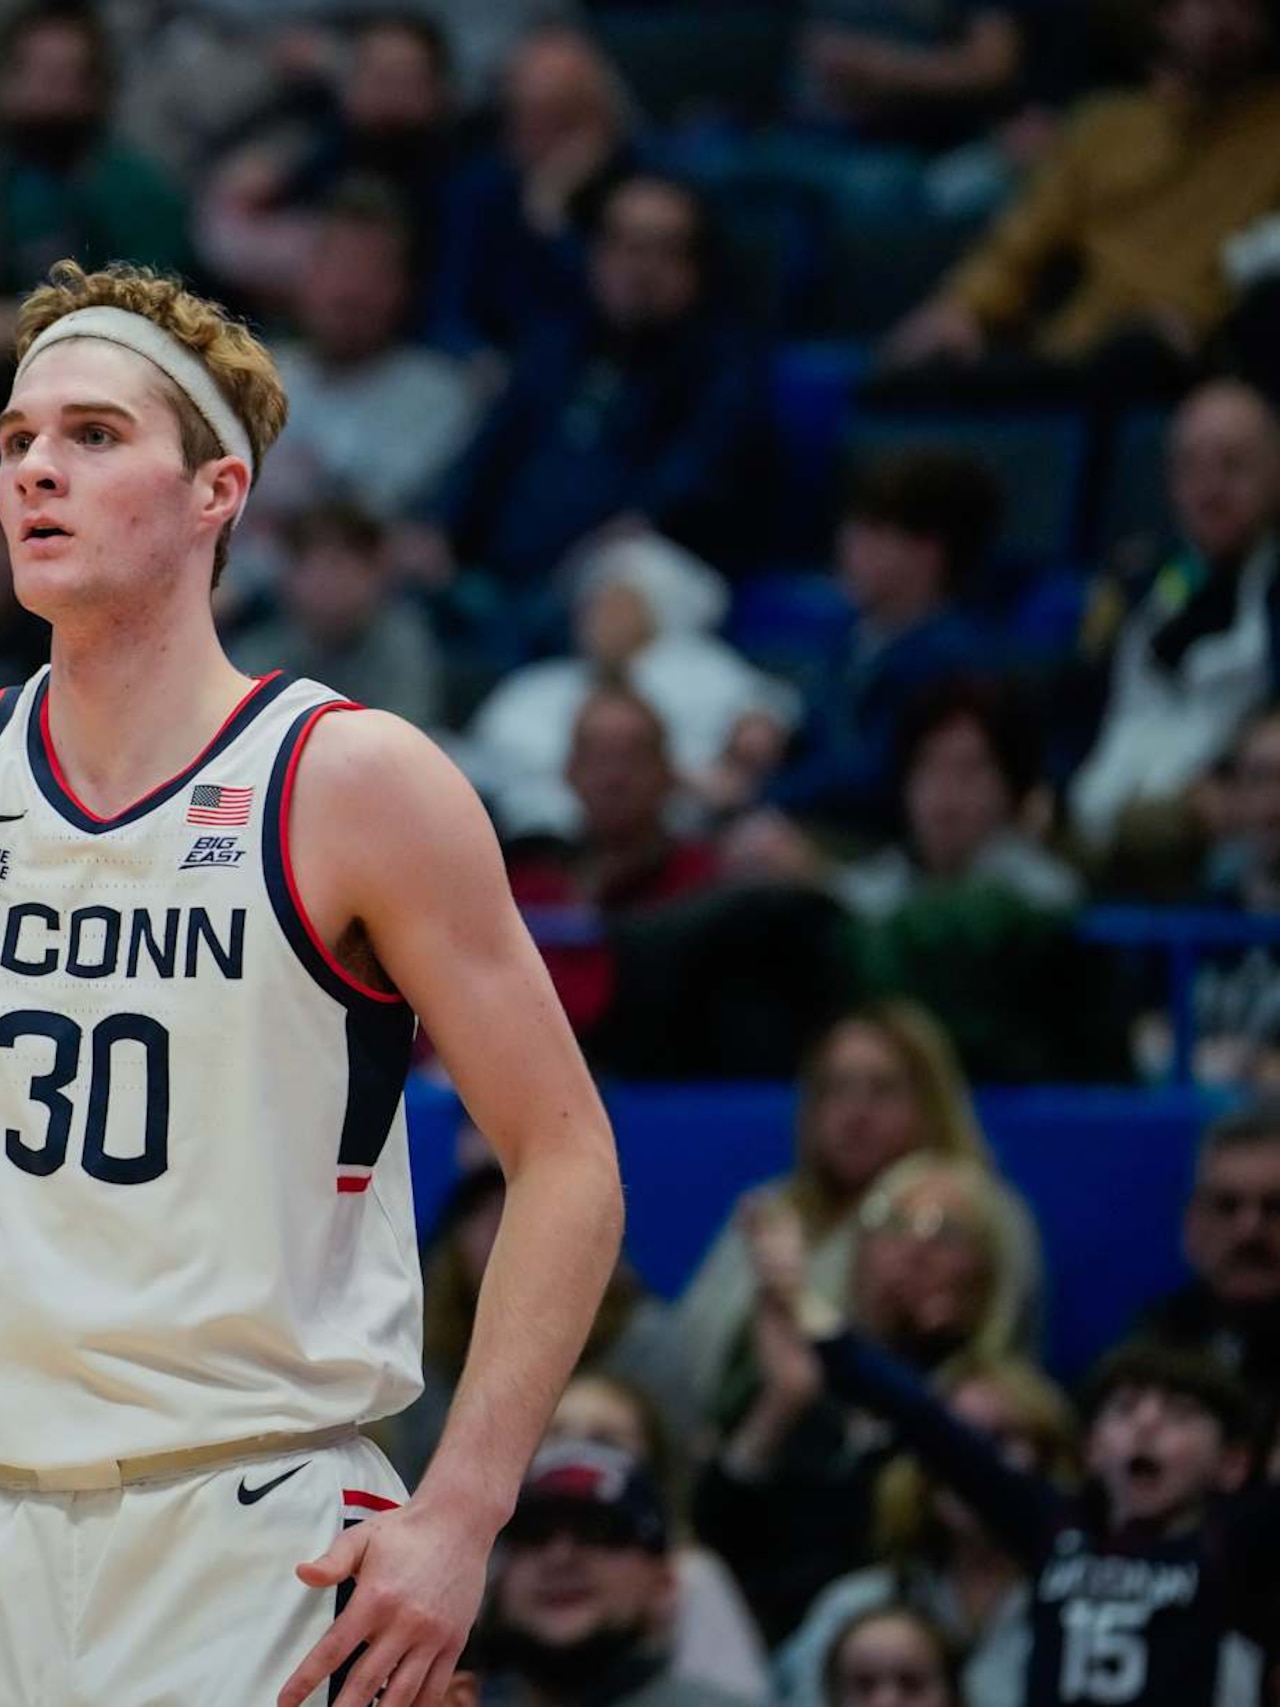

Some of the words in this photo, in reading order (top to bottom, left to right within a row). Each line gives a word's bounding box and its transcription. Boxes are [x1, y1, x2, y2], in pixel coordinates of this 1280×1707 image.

[193, 836, 238, 849] BIG
[184, 850, 247, 863] EAST
[1059, 1599, 1150, 1704] 15
